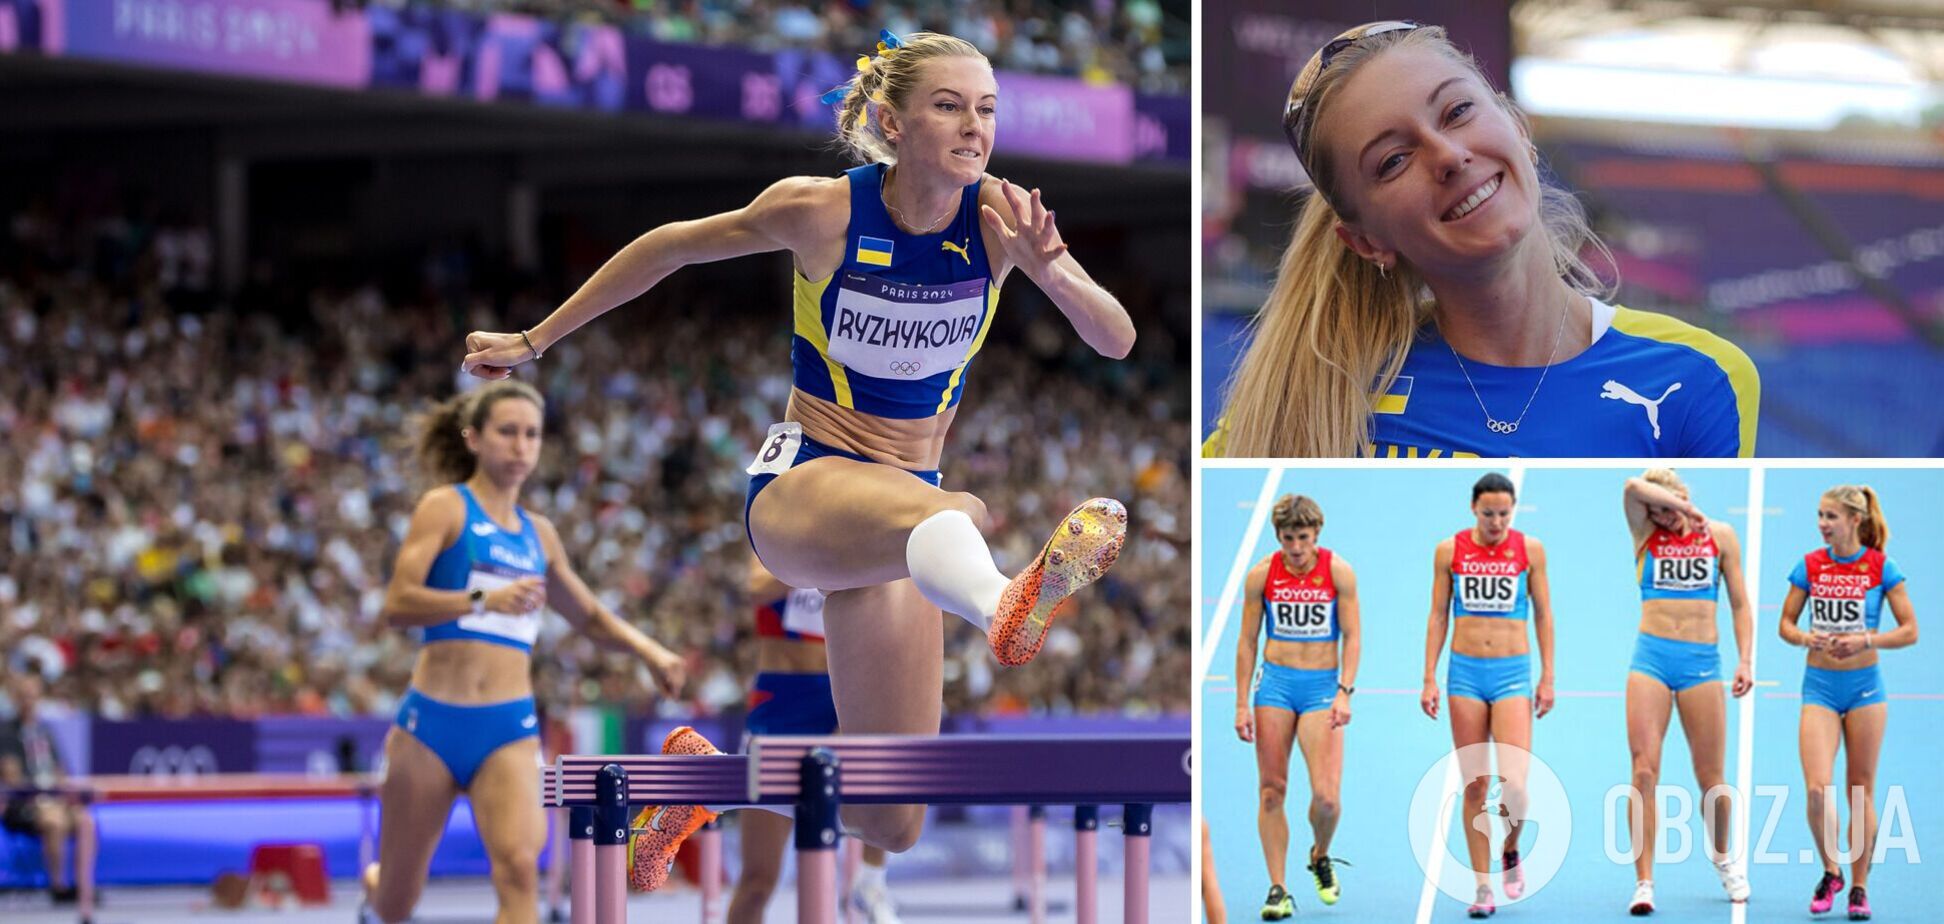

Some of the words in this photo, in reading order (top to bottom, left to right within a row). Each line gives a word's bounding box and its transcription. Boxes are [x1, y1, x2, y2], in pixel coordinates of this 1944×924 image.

[881, 284, 918, 299] PARIS
[922, 289, 953, 300] 2024
[837, 307, 977, 349] RYZHYKOVA
[763, 433, 787, 462] 8
[1657, 545, 1713, 557] TOYOTA
[1462, 561, 1517, 574] TOYOTA
[1660, 557, 1708, 580] RUS
[1273, 587, 1329, 600] TOYOTA
[1465, 577, 1512, 600] RUS
[1811, 583, 1862, 597] TOYOTA
[1278, 604, 1326, 627] RUS
[1814, 600, 1860, 622] RUS
